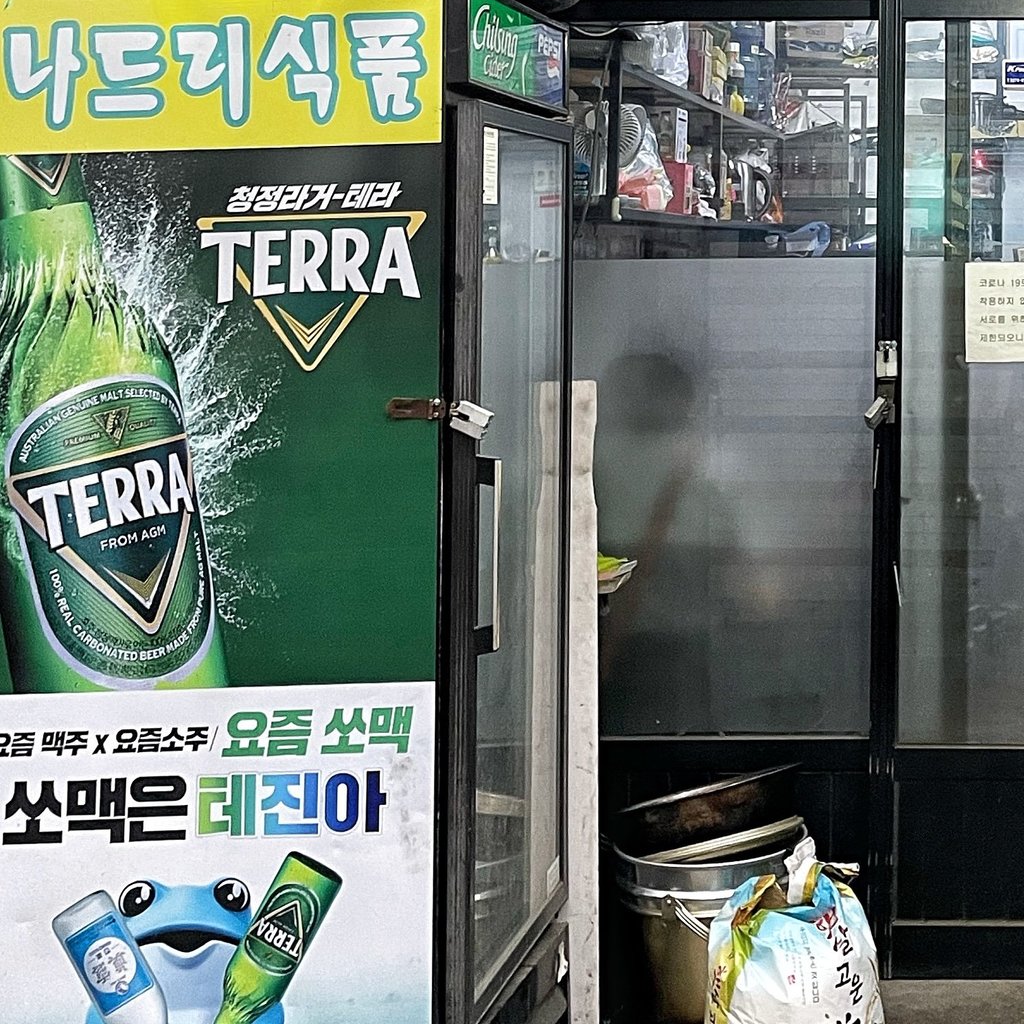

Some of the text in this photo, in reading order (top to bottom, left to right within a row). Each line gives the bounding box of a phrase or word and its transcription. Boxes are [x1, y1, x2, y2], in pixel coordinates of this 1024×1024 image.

[4, 11, 427, 130] 나드리식품
[226, 182, 402, 213] 청정라거-테라
[200, 226, 421, 304] TERRA
[979, 278, 1005, 287] 코로나
[980, 297, 1014, 306] 착용하지
[980, 315, 1006, 324] 서로를
[19, 412, 61, 464] AUSTRALIAN
[60, 396, 101, 420] GENUINE
[100, 388, 124, 403] MALT
[124, 387, 161, 401] SELECTED
[27, 452, 195, 550] TERRA
[100, 524, 167, 552] FROM AGM
[57, 596, 74, 627] REAL
[72, 623, 138, 662] CARBONATED
[139, 645, 167, 661] BEER
[165, 632, 190, 654] MADE
[41, 730, 89, 757] 맥주
[113, 726, 209, 754] 요즘소주
[221, 708, 313, 758] 요즘
[320, 705, 414, 755] 쏘맥
[2, 770, 387, 845] 쏘맥은 테진아
[256, 917, 302, 958] TERRA
